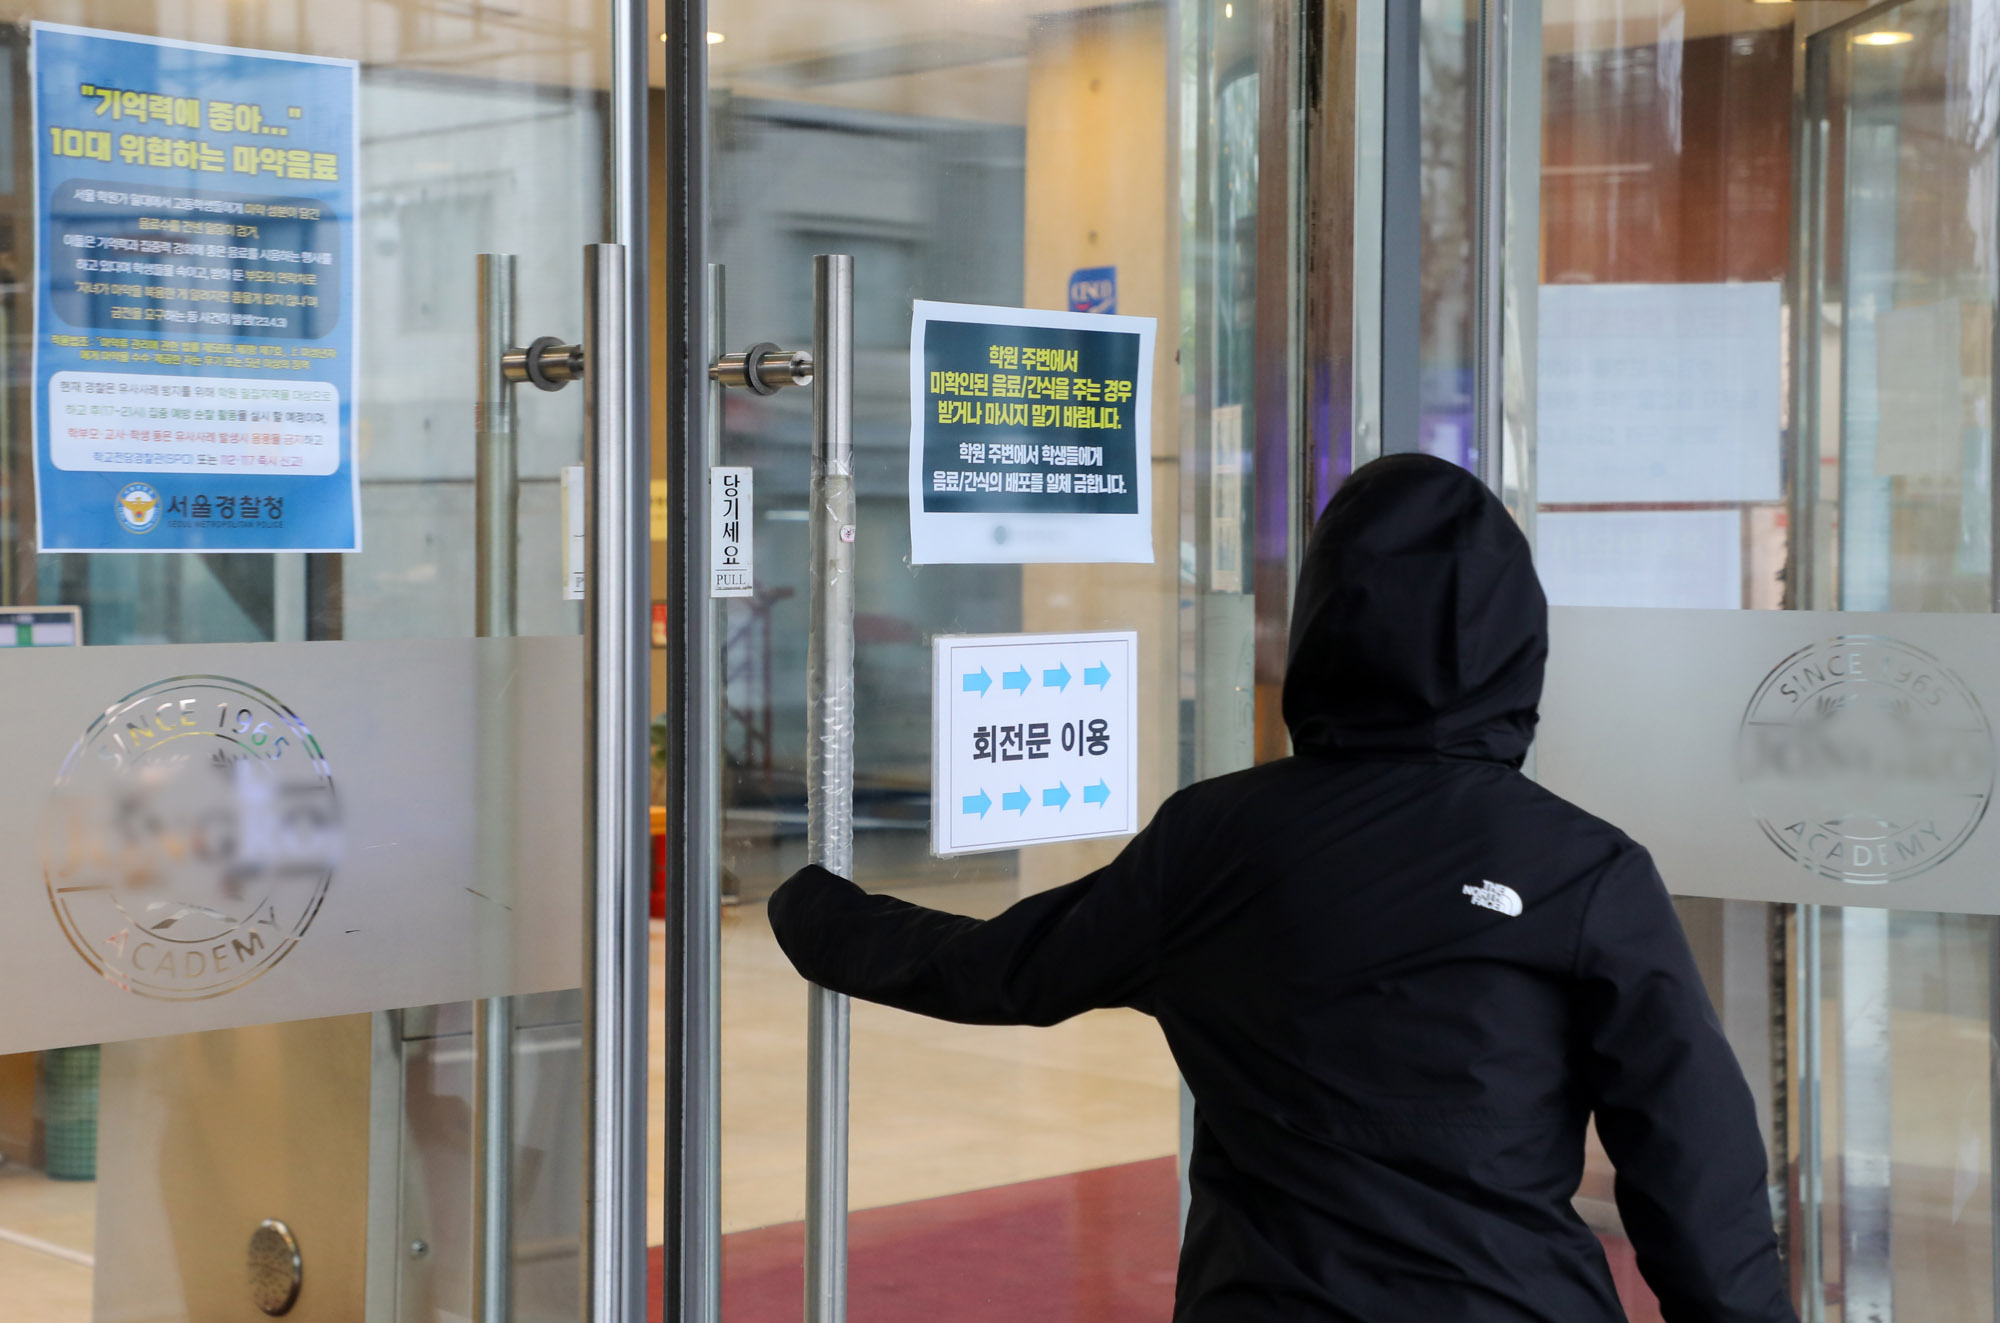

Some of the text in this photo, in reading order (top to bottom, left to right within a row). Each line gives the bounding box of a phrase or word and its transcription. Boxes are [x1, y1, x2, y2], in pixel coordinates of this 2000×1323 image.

[81, 83, 302, 136] "기억력에 좋아..."
[49, 126, 339, 181] 10대 위협하는 마약음료
[989, 345, 1078, 373] 학원 주변에서
[60, 381, 81, 393] 현재
[85, 382, 116, 394] 경찰은
[118, 383, 158, 396] 유사사례
[930, 371, 1132, 403] 미확인된 음료/간식을 주는 경우
[938, 400, 1122, 430] 받거나 마시지 말기 바랍니다.
[197, 454, 218, 466] 또는
[959, 442, 1103, 466] 학원 주변에서 학생들에게
[932, 470, 1127, 494] 음료/간식의 배포를 일체 금합니다.
[168, 494, 284, 520] 서울경찰청
[722, 473, 741, 565] 당기세요
[716, 574, 746, 585] PULL
[1780, 653, 1863, 704] SINCE
[98, 698, 291, 770] SINCE 1965
[972, 718, 1110, 763] 회전문 이용
[1784, 820, 1943, 867] ACADEMY
[103, 906, 281, 980] ACADEMY
